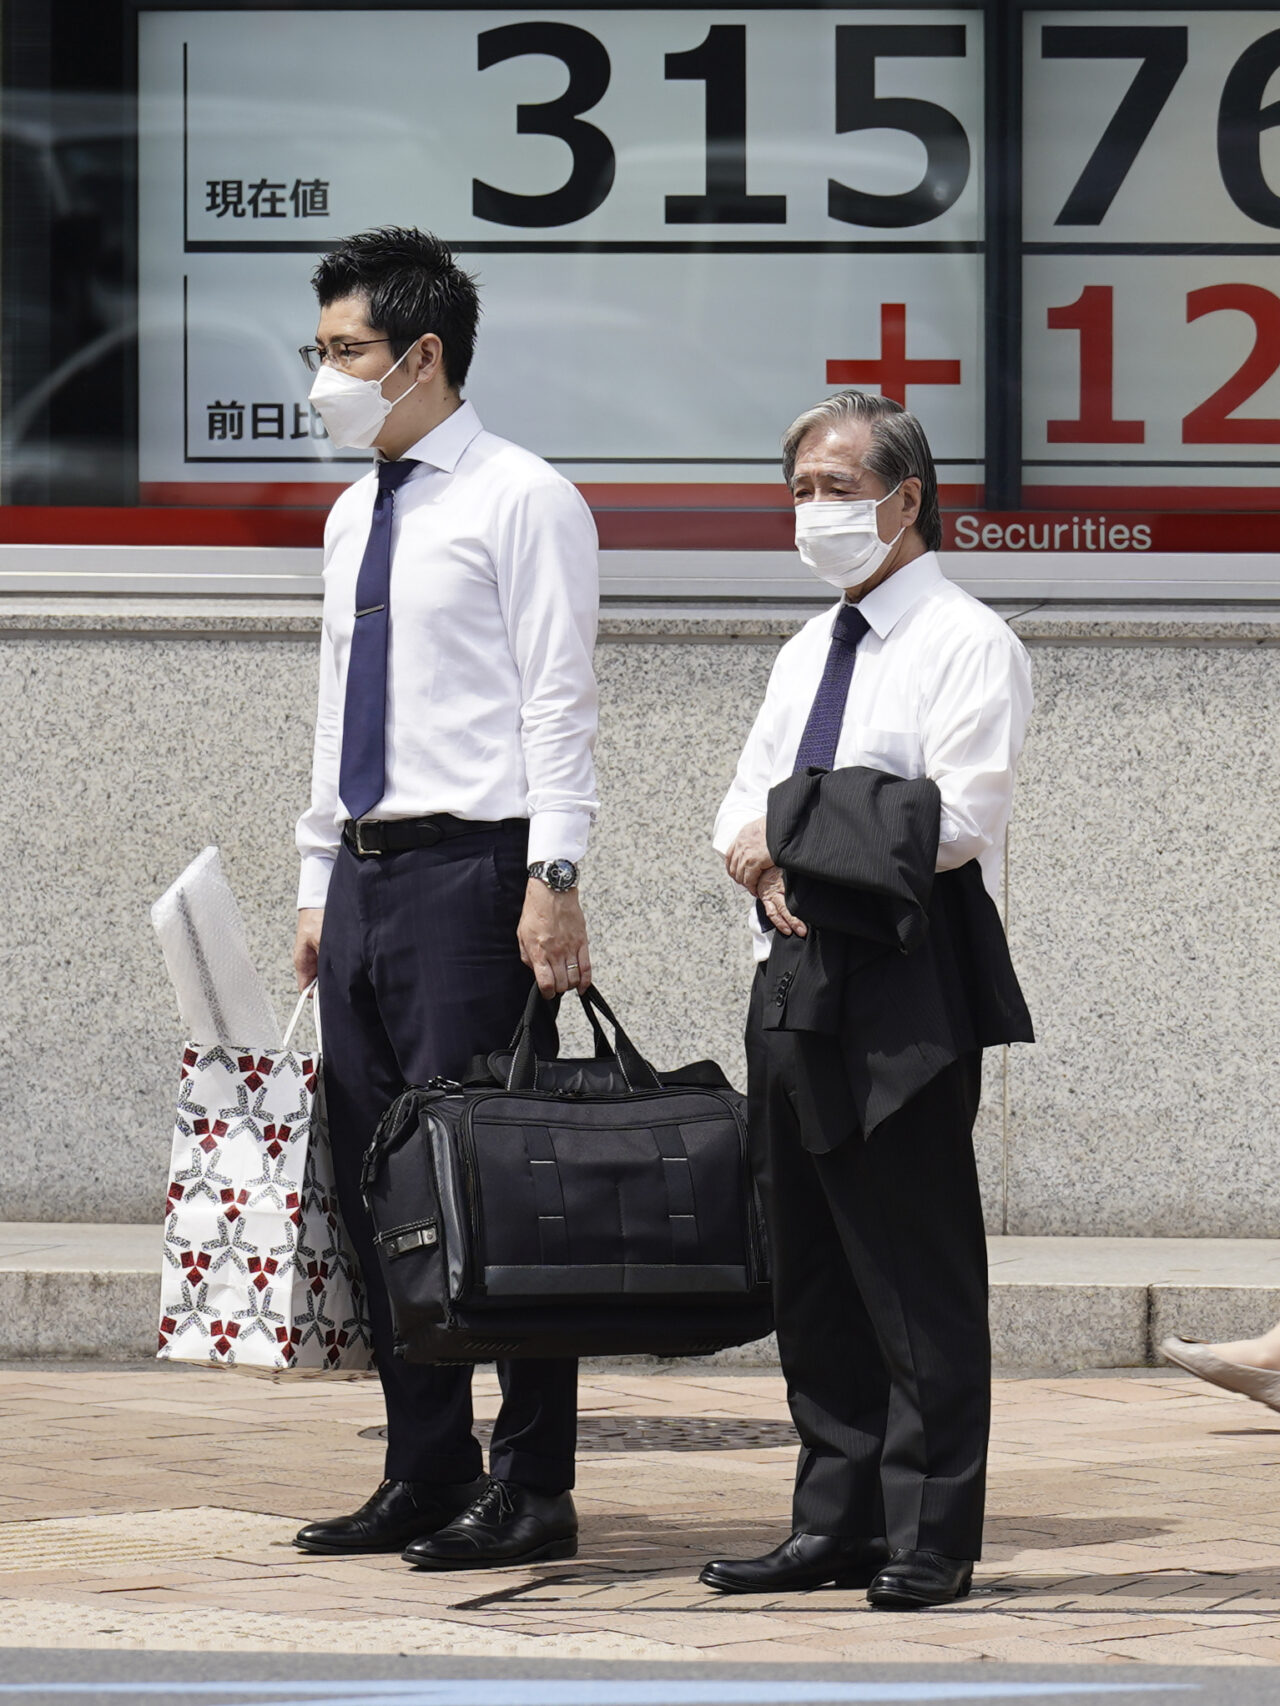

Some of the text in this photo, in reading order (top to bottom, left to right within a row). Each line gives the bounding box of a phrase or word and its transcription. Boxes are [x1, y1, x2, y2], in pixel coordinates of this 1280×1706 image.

[205, 178, 330, 219] 現在値
[206, 400, 329, 440] 前日比
[954, 515, 1152, 550] Securities
